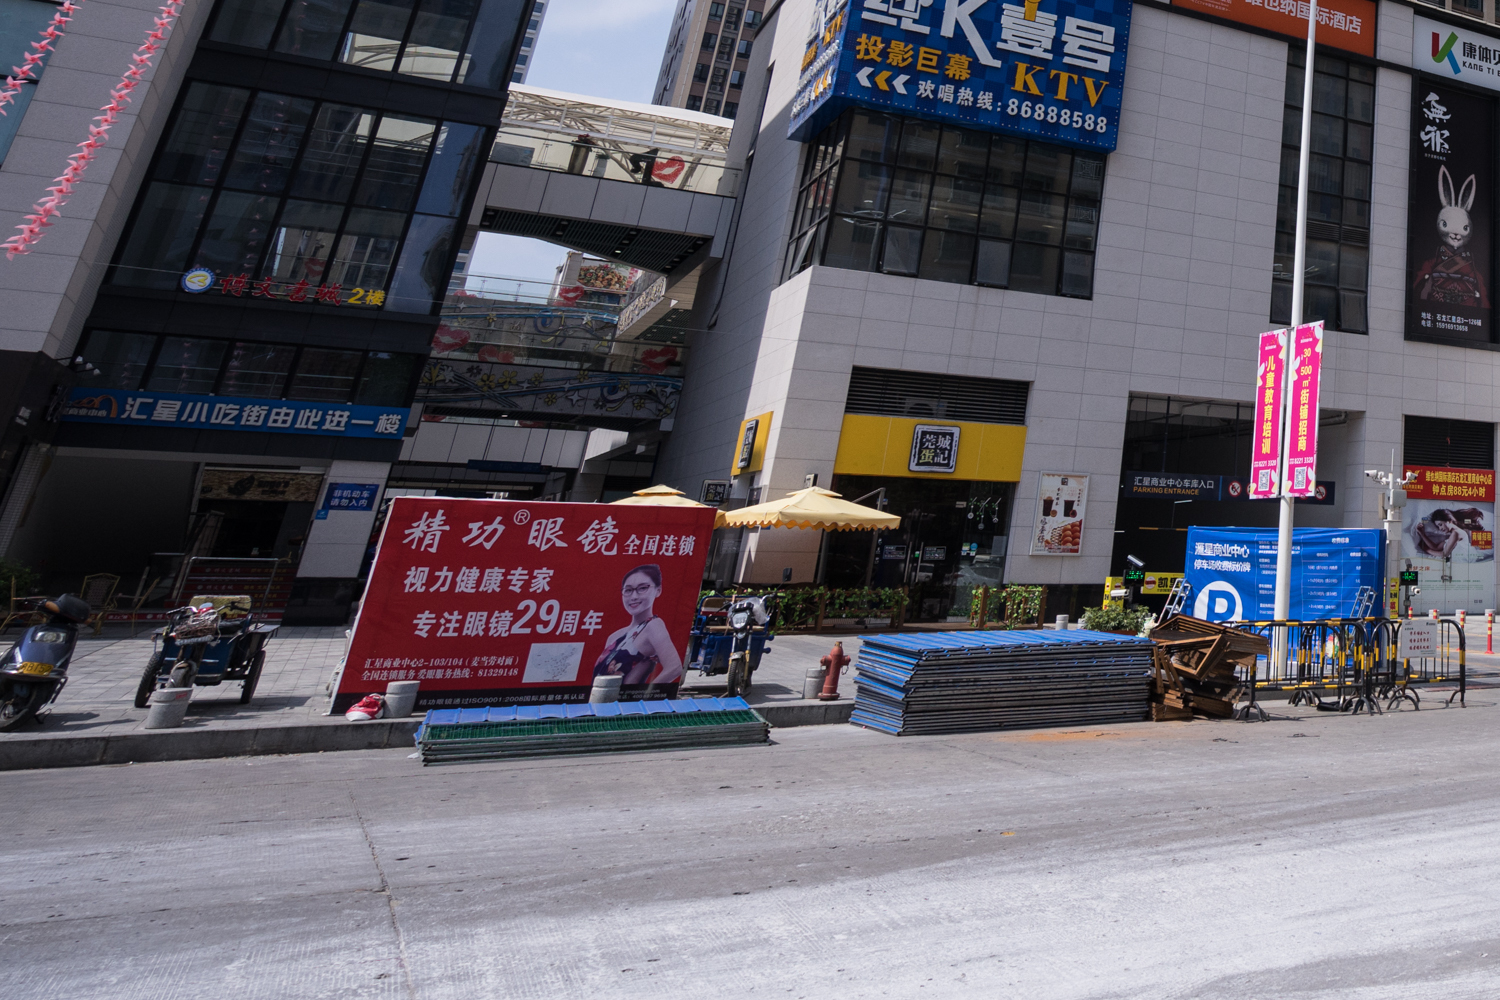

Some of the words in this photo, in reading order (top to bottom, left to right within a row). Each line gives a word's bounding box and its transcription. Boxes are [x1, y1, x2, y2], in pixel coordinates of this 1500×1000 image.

[856, 33, 973, 81] 投影巨幕
[1462, 60, 1483, 72] KANG
[1487, 67, 1494, 75] TI
[1011, 61, 1109, 107] KTV
[917, 80, 1107, 133] 欢唱热线:86888588
[347, 288, 386, 306] 2楼
[1262, 355, 1276, 455] 儿童教育培训
[120, 397, 402, 434] 汇星小吃街由此进一楼
[922, 434, 951, 450] 莞城
[1133, 486, 1163, 494] PARKING
[1134, 476, 1214, 489] 汇星商业中心车库入口
[333, 490, 370, 498] 非机动车
[623, 534, 695, 556] 全国连锁
[1194, 559, 1251, 573] 停车场收费标价牌
[404, 567, 554, 594] 视力健康专家
[412, 600, 603, 638] 专注眼镜29周年
[361, 670, 416, 681] 全国连锁服务
